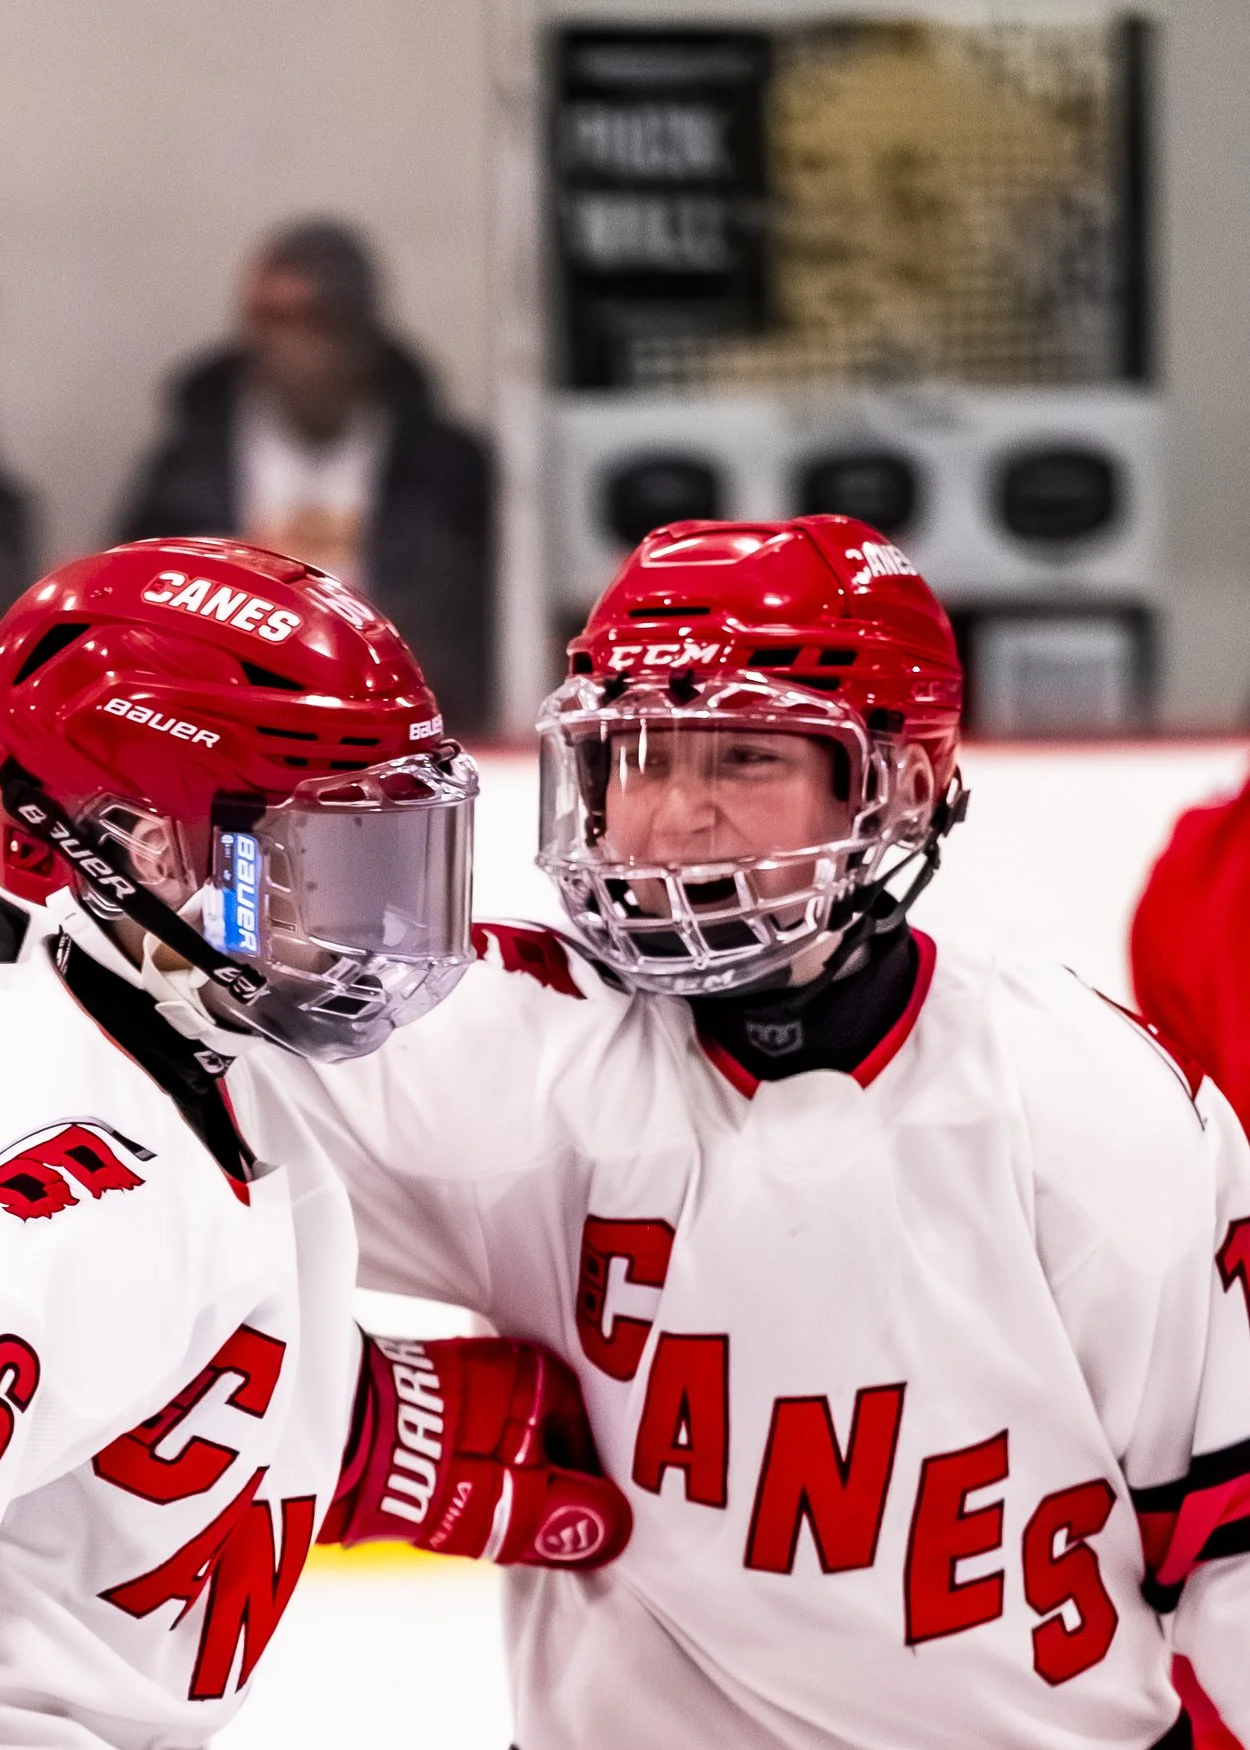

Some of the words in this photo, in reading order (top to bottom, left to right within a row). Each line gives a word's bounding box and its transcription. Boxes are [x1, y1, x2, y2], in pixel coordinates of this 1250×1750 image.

[144, 572, 301, 643] CANES
[608, 643, 720, 668] CCM
[103, 697, 221, 748] BAUER
[236, 835, 258, 952] BAUER
[575, 1215, 1119, 1687] CANES
